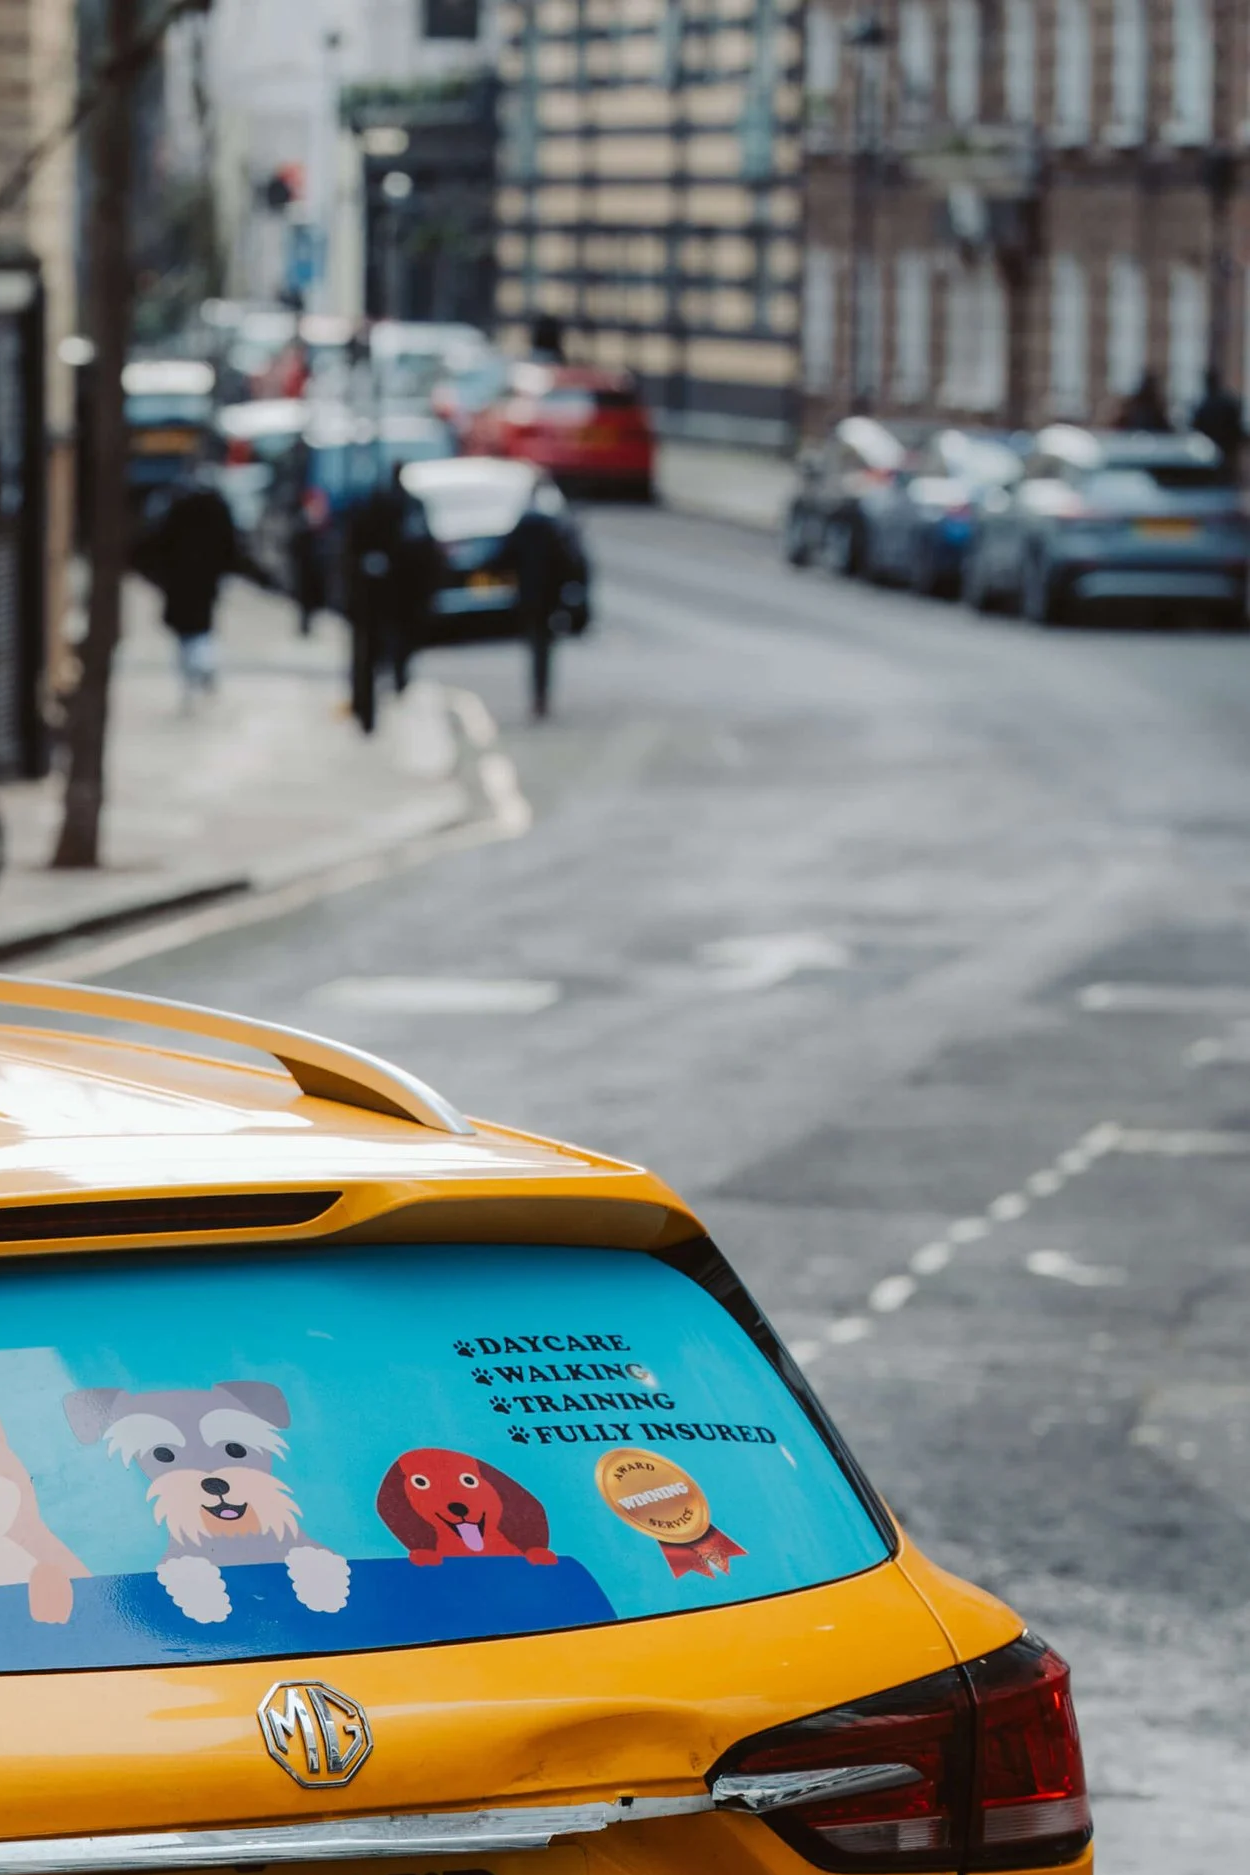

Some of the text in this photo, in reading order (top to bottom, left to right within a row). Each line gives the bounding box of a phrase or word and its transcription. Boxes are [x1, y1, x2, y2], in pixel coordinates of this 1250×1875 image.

[475, 1334, 631, 1355] DAYCARE
[495, 1363, 651, 1384] WALKING
[513, 1392, 676, 1414] TRAINING
[534, 1423, 777, 1444] FULLY INSURED
[614, 1461, 655, 1482] AWARD
[618, 1481, 690, 1510] WINNING
[649, 1507, 694, 1529] SERVICE
[263, 1685, 365, 1776] MG
